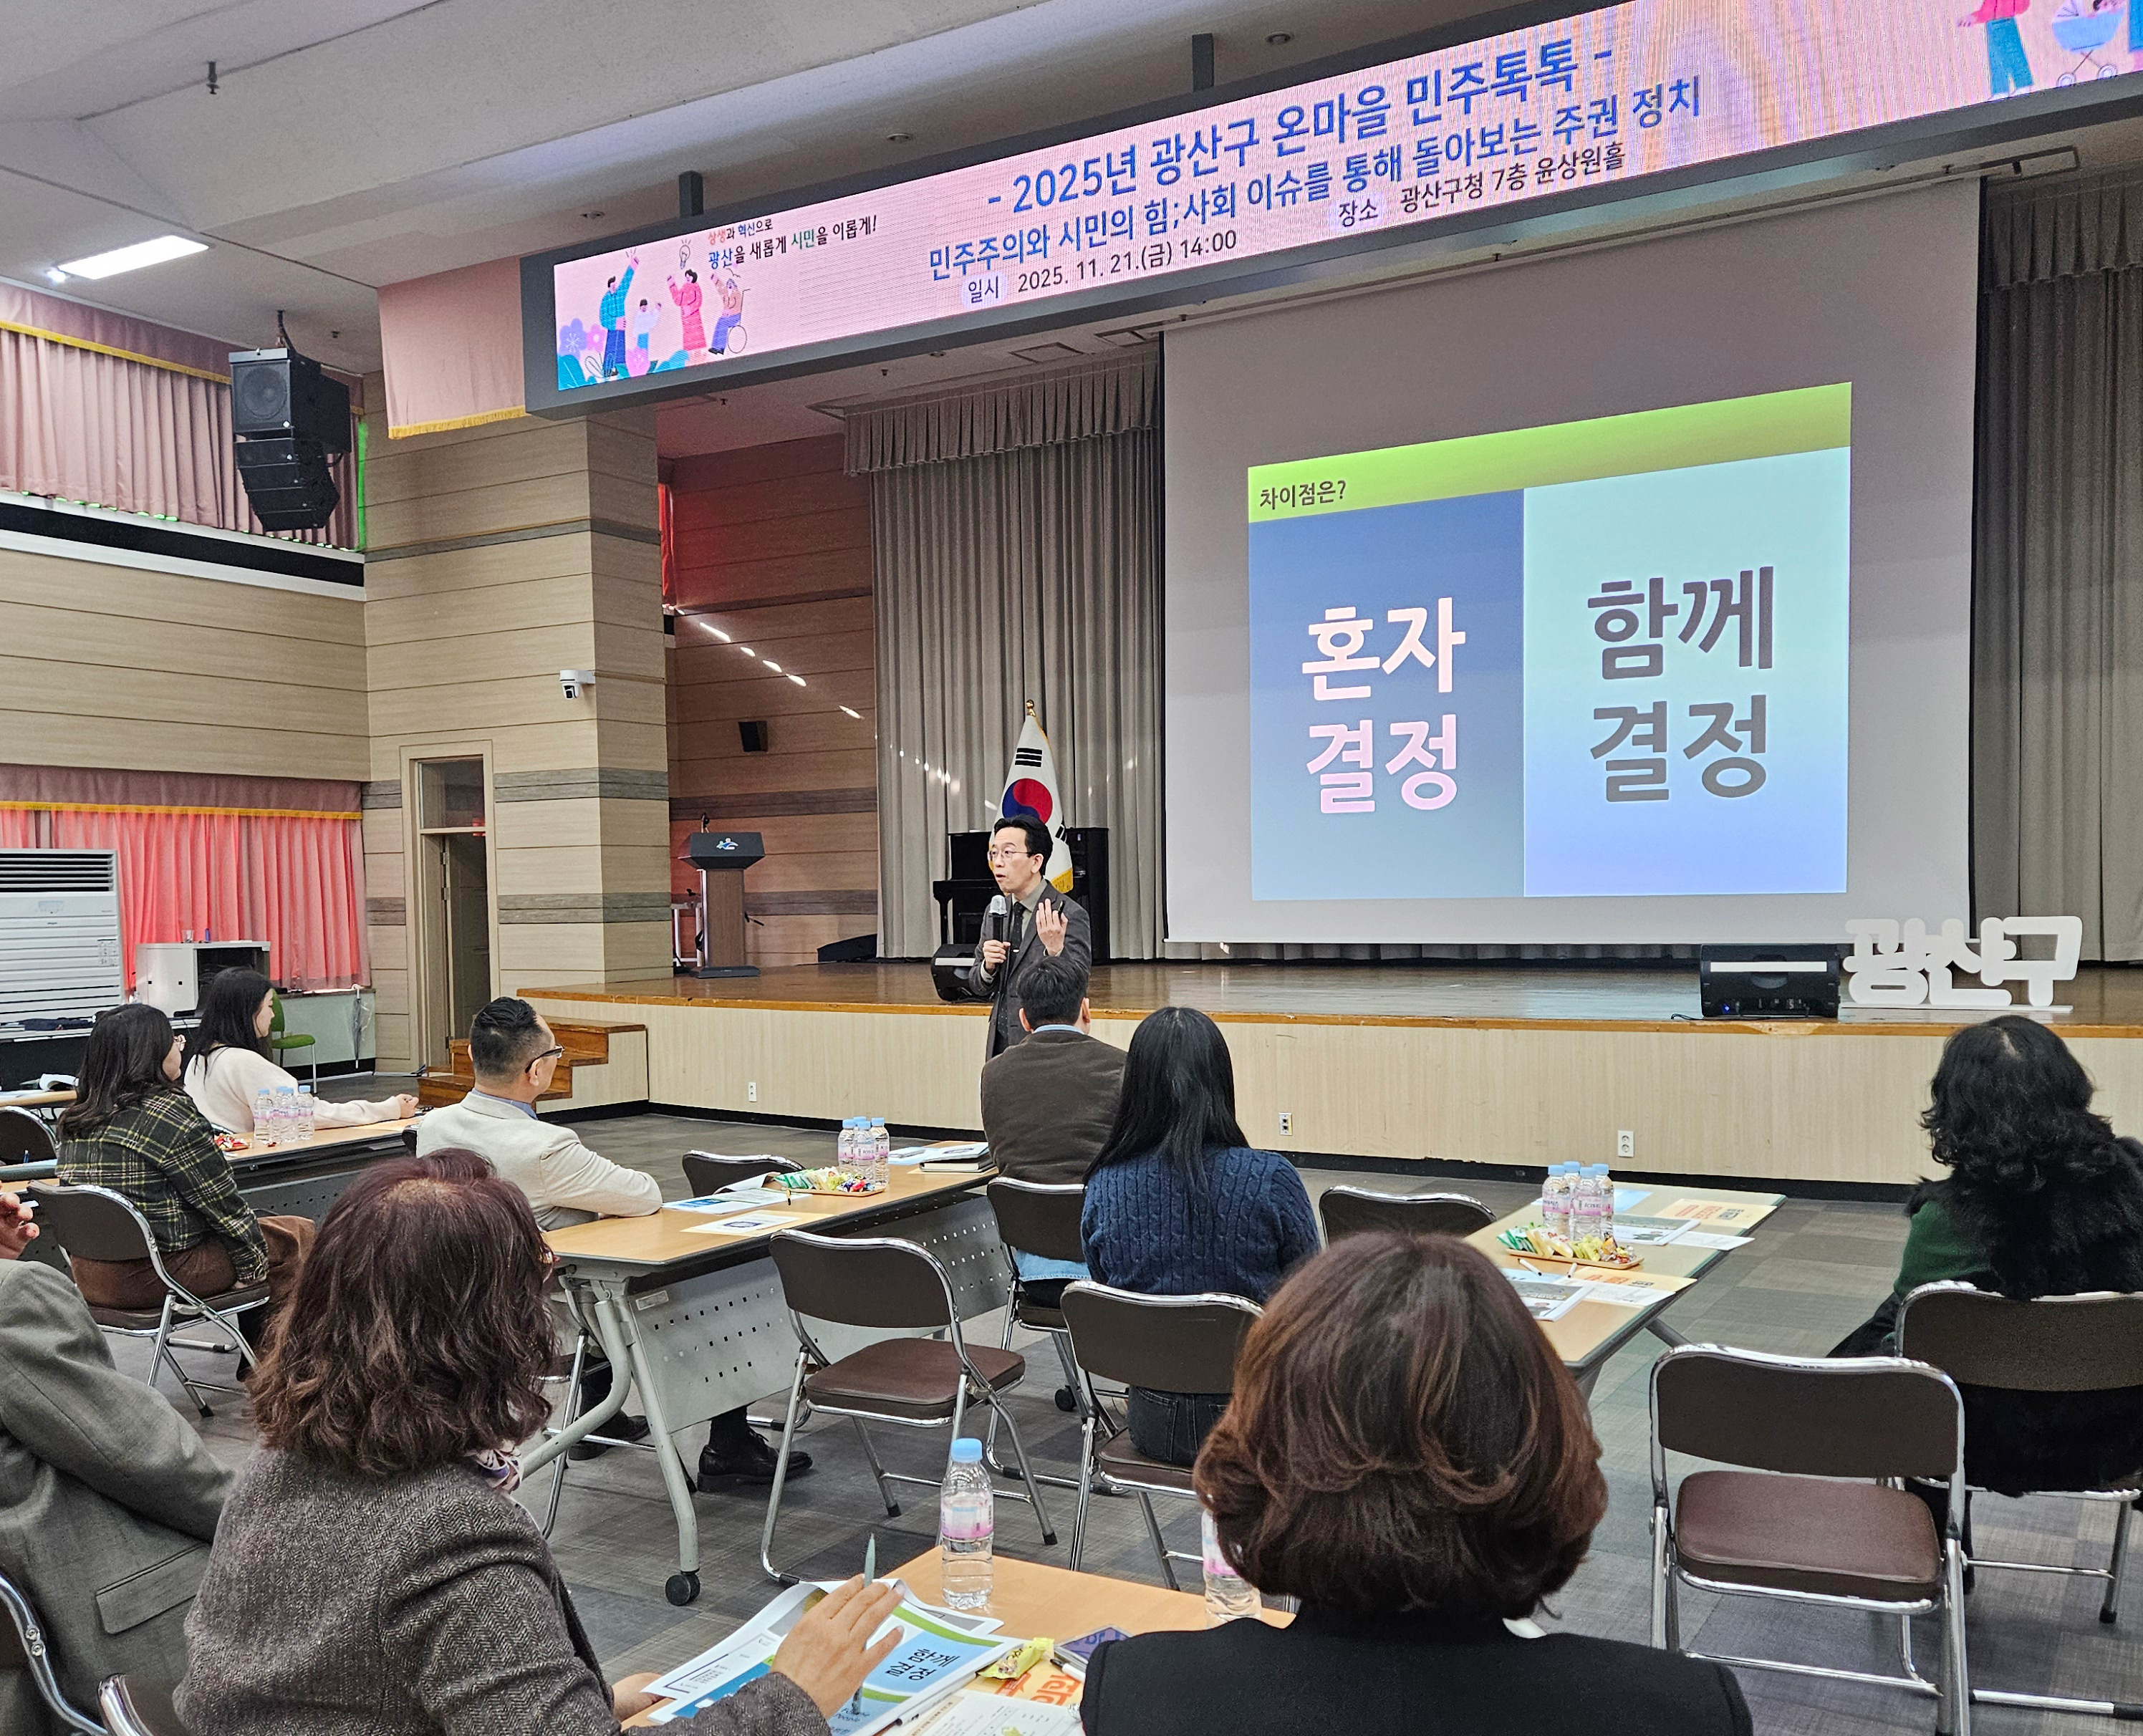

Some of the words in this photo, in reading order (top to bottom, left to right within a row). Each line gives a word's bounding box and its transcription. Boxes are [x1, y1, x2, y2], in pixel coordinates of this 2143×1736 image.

[1013, 144, 1137, 213] 2025년
[1150, 117, 1261, 185] 광산구
[1272, 85, 1391, 158] 온마을
[1407, 39, 1579, 127] 민주톡톡
[930, 224, 1051, 281] 민주주의와
[1059, 205, 1134, 252] 시민의
[1247, 160, 1333, 211] 이슈를
[1342, 144, 1402, 193] 통해
[1412, 117, 1542, 179] 돌아보는
[1553, 94, 1618, 145] 주권
[1632, 75, 1700, 130] 정치
[1338, 198, 1378, 228] 장소
[1401, 173, 1483, 215] 광산구청
[1491, 164, 1528, 192] 7층
[1536, 142, 1626, 185] 윤상원홀
[708, 227, 736, 246] 상생과
[738, 218, 774, 238] 혁신으로
[708, 246, 746, 269] 광산을
[749, 235, 786, 260] 새롭게
[791, 226, 829, 250] 시민을
[832, 214, 877, 241] 이롭게!
[968, 276, 1000, 304] 일시
[1018, 265, 1068, 292] 2025.
[1077, 260, 1104, 279] 11.
[1110, 242, 1172, 275] 21.(금)
[1180, 229, 1237, 259] 14:00
[1258, 479, 1347, 511] 차이점은?
[1301, 597, 1466, 701] 혼자
[1587, 566, 1774, 680] 함께
[1306, 713, 1458, 814] 결정
[1590, 695, 1767, 803] 결정
[1843, 916, 2083, 1007] 광산구
[885, 1661, 938, 1681] 결정
[907, 1648, 960, 1667] 함께
